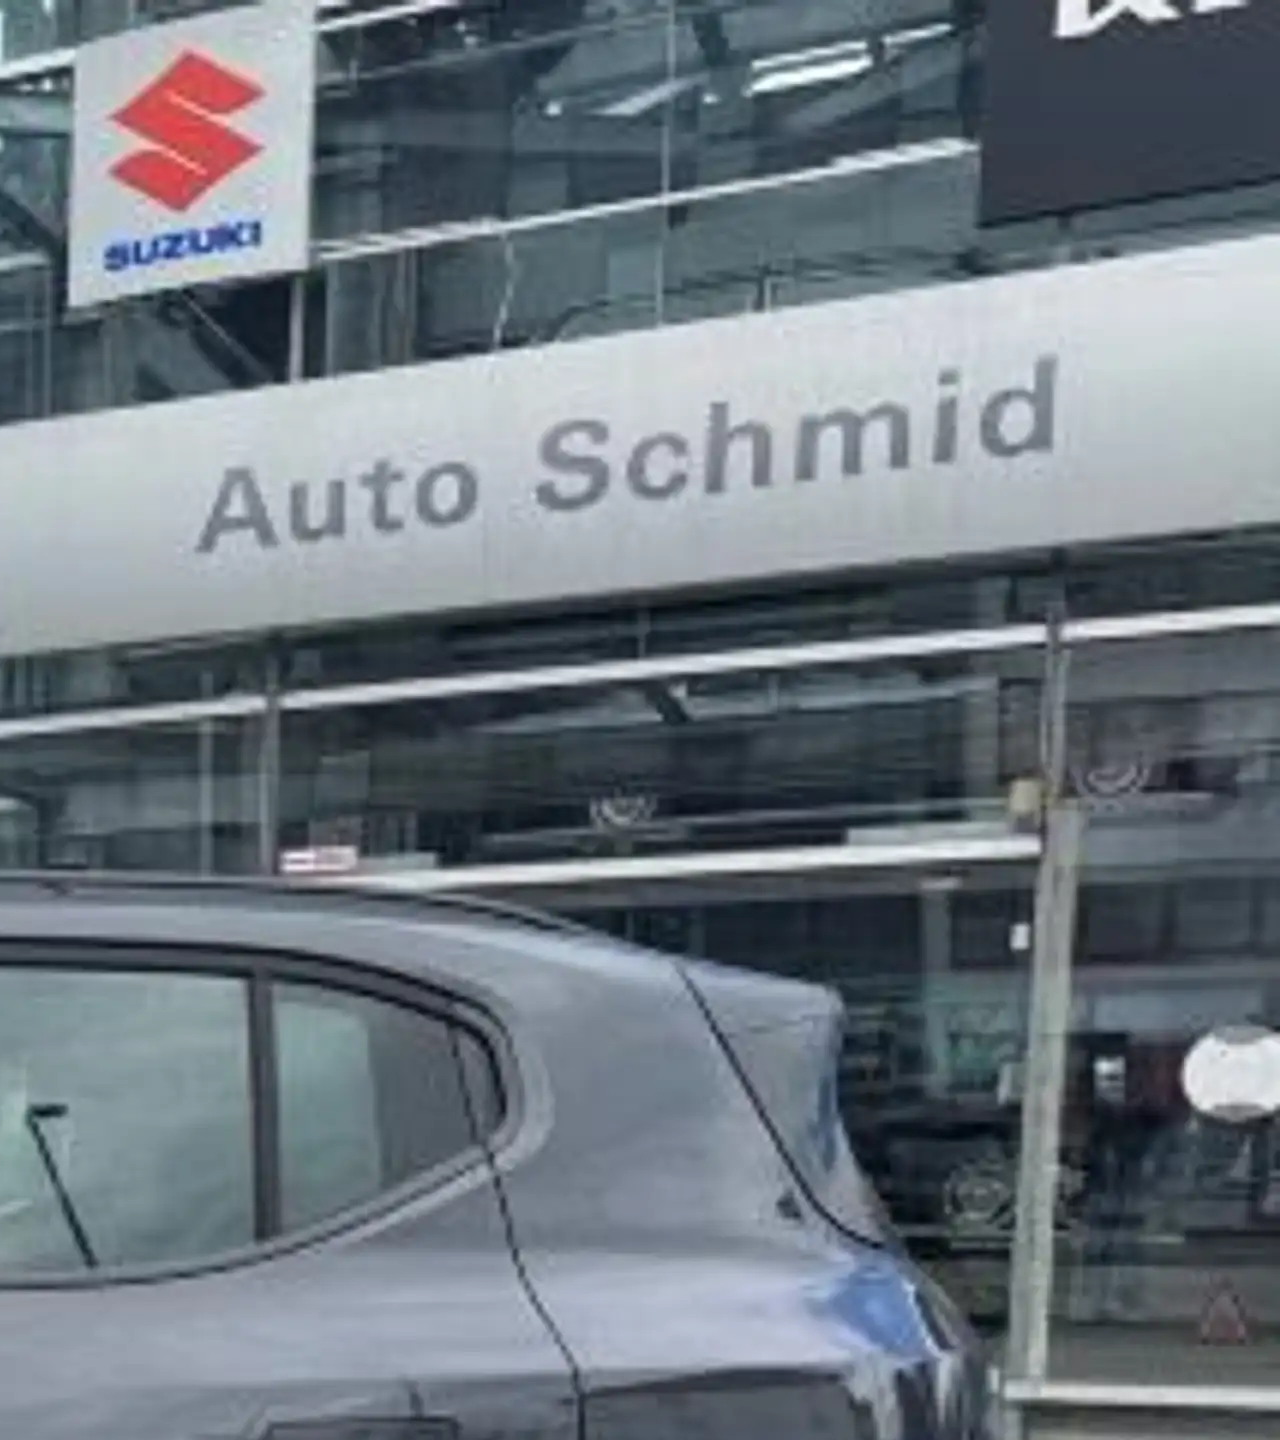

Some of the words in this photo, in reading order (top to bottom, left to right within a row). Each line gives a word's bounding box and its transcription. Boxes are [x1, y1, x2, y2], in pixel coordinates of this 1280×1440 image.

[103, 219, 263, 272] SUZUKI
[195, 459, 480, 554] Auto
[535, 354, 1059, 512] Schmid
